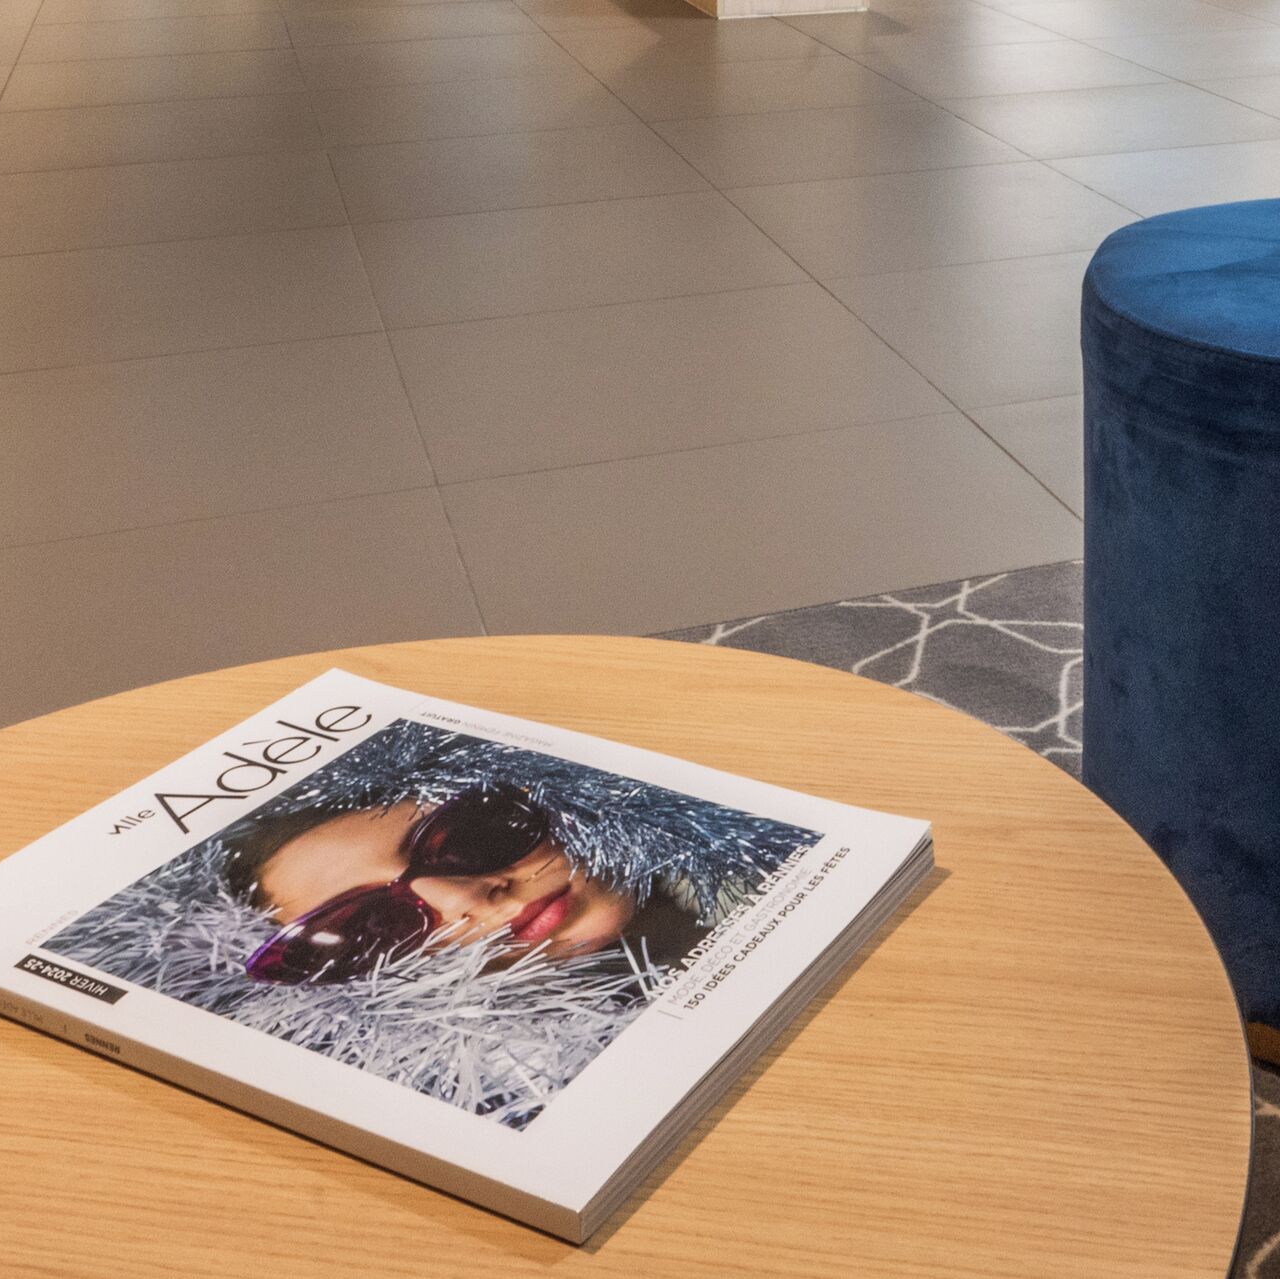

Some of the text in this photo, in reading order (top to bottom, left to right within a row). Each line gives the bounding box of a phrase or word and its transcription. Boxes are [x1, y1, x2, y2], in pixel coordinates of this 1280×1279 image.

[421, 711, 461, 725] GRATUIT
[154, 705, 373, 835] Adèle
[650, 966, 682, 999] NOS
[681, 904, 748, 972] ADRESSES
[757, 845, 811, 895] RENNES
[683, 846, 851, 1010] 150 IDÉES CADEAUX POUR LES FÊTES
[730, 930, 747, 945] ET
[743, 868, 812, 932] GASTRONOMIE
[70, 974, 109, 997] HIVER
[85, 1032, 120, 1055] RENNES
